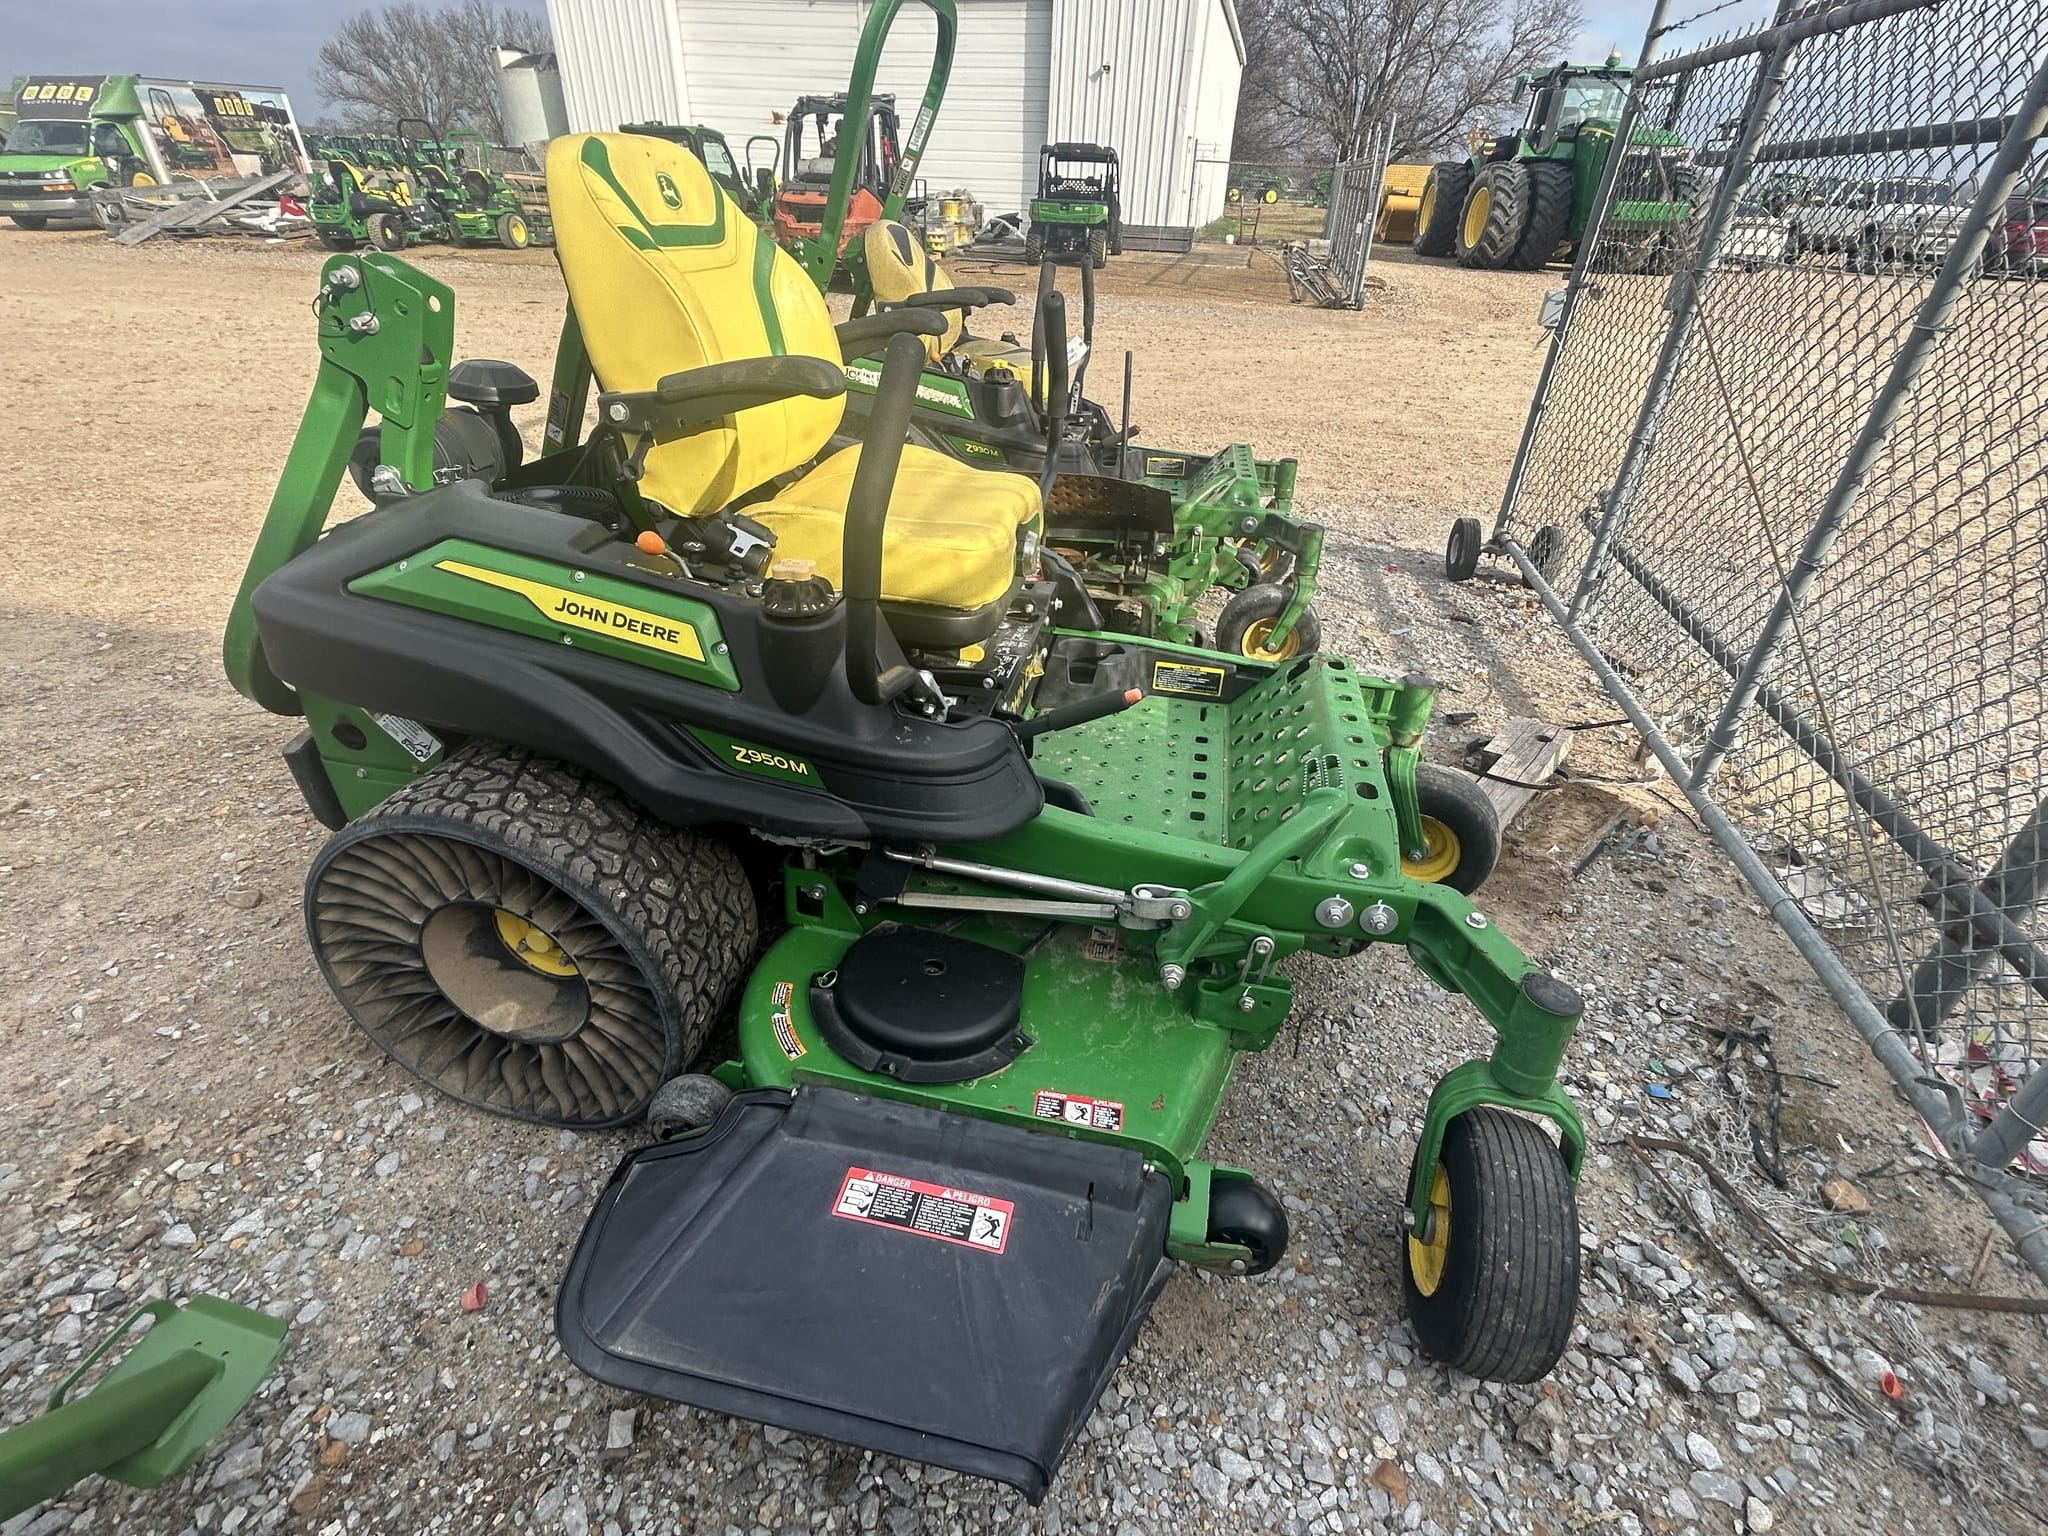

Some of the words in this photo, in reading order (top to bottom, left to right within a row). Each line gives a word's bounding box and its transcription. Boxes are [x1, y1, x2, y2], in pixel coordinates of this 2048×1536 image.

[554, 598, 608, 624] JOHN
[612, 612, 680, 644] DEERE
[874, 1173, 912, 1188] DANGER
[952, 1190, 991, 1207] PELIGRO
